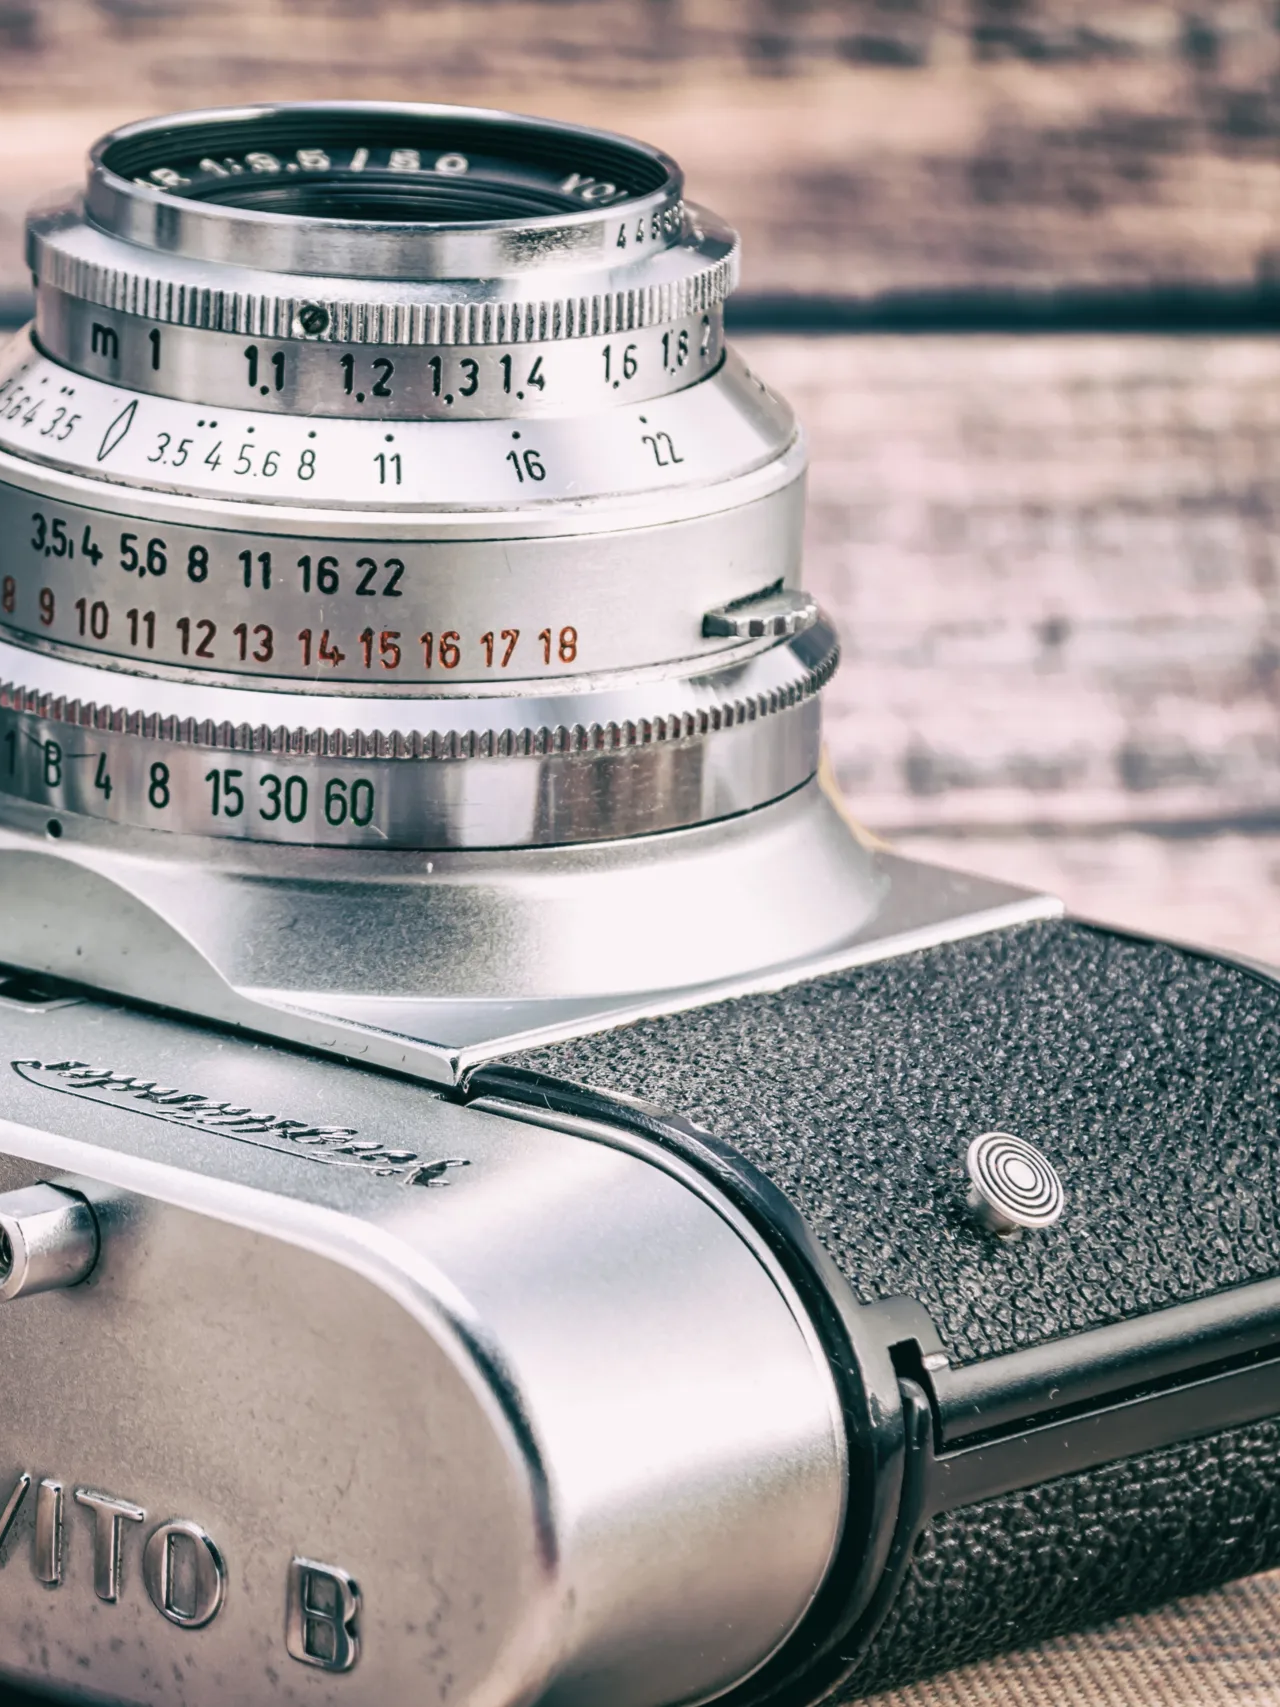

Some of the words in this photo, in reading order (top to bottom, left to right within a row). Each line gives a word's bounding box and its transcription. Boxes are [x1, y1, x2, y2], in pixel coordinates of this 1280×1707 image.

[91, 321, 119, 360] m
[148, 327, 161, 372] 1
[146, 432, 195, 467] 3.5
[203, 440, 223, 472] 4
[233, 443, 281, 478] 5.6
[297, 449, 317, 481] 8
[372, 453, 403, 485] 11
[505, 449, 547, 483] 16
[641, 431, 685, 467] 22
[81, 525, 103, 566] 4
[187, 545, 209, 583] 8
[239, 550, 272, 590] 11
[297, 555, 339, 595] 16
[355, 557, 406, 597] 22
[1, 574, 17, 614] 8
[38, 587, 56, 627] 9
[75, 597, 109, 640] 10
[126, 608, 156, 649] 11
[176, 616, 217, 659] 12
[233, 623, 274, 663] 13
[298, 628, 346, 668] 14
[358, 627, 402, 670] 15
[420, 631, 461, 670] 16
[480, 629, 520, 668] 17
[538, 626, 578, 665] 18
[3, 729, 17, 776] 1
[43, 739, 63, 788] B
[94, 751, 113, 800] 4
[148, 761, 171, 809] 8
[205, 769, 245, 817] 15
[258, 773, 309, 824] 30
[324, 778, 376, 827] 60
[285, 1555, 363, 1674] B
